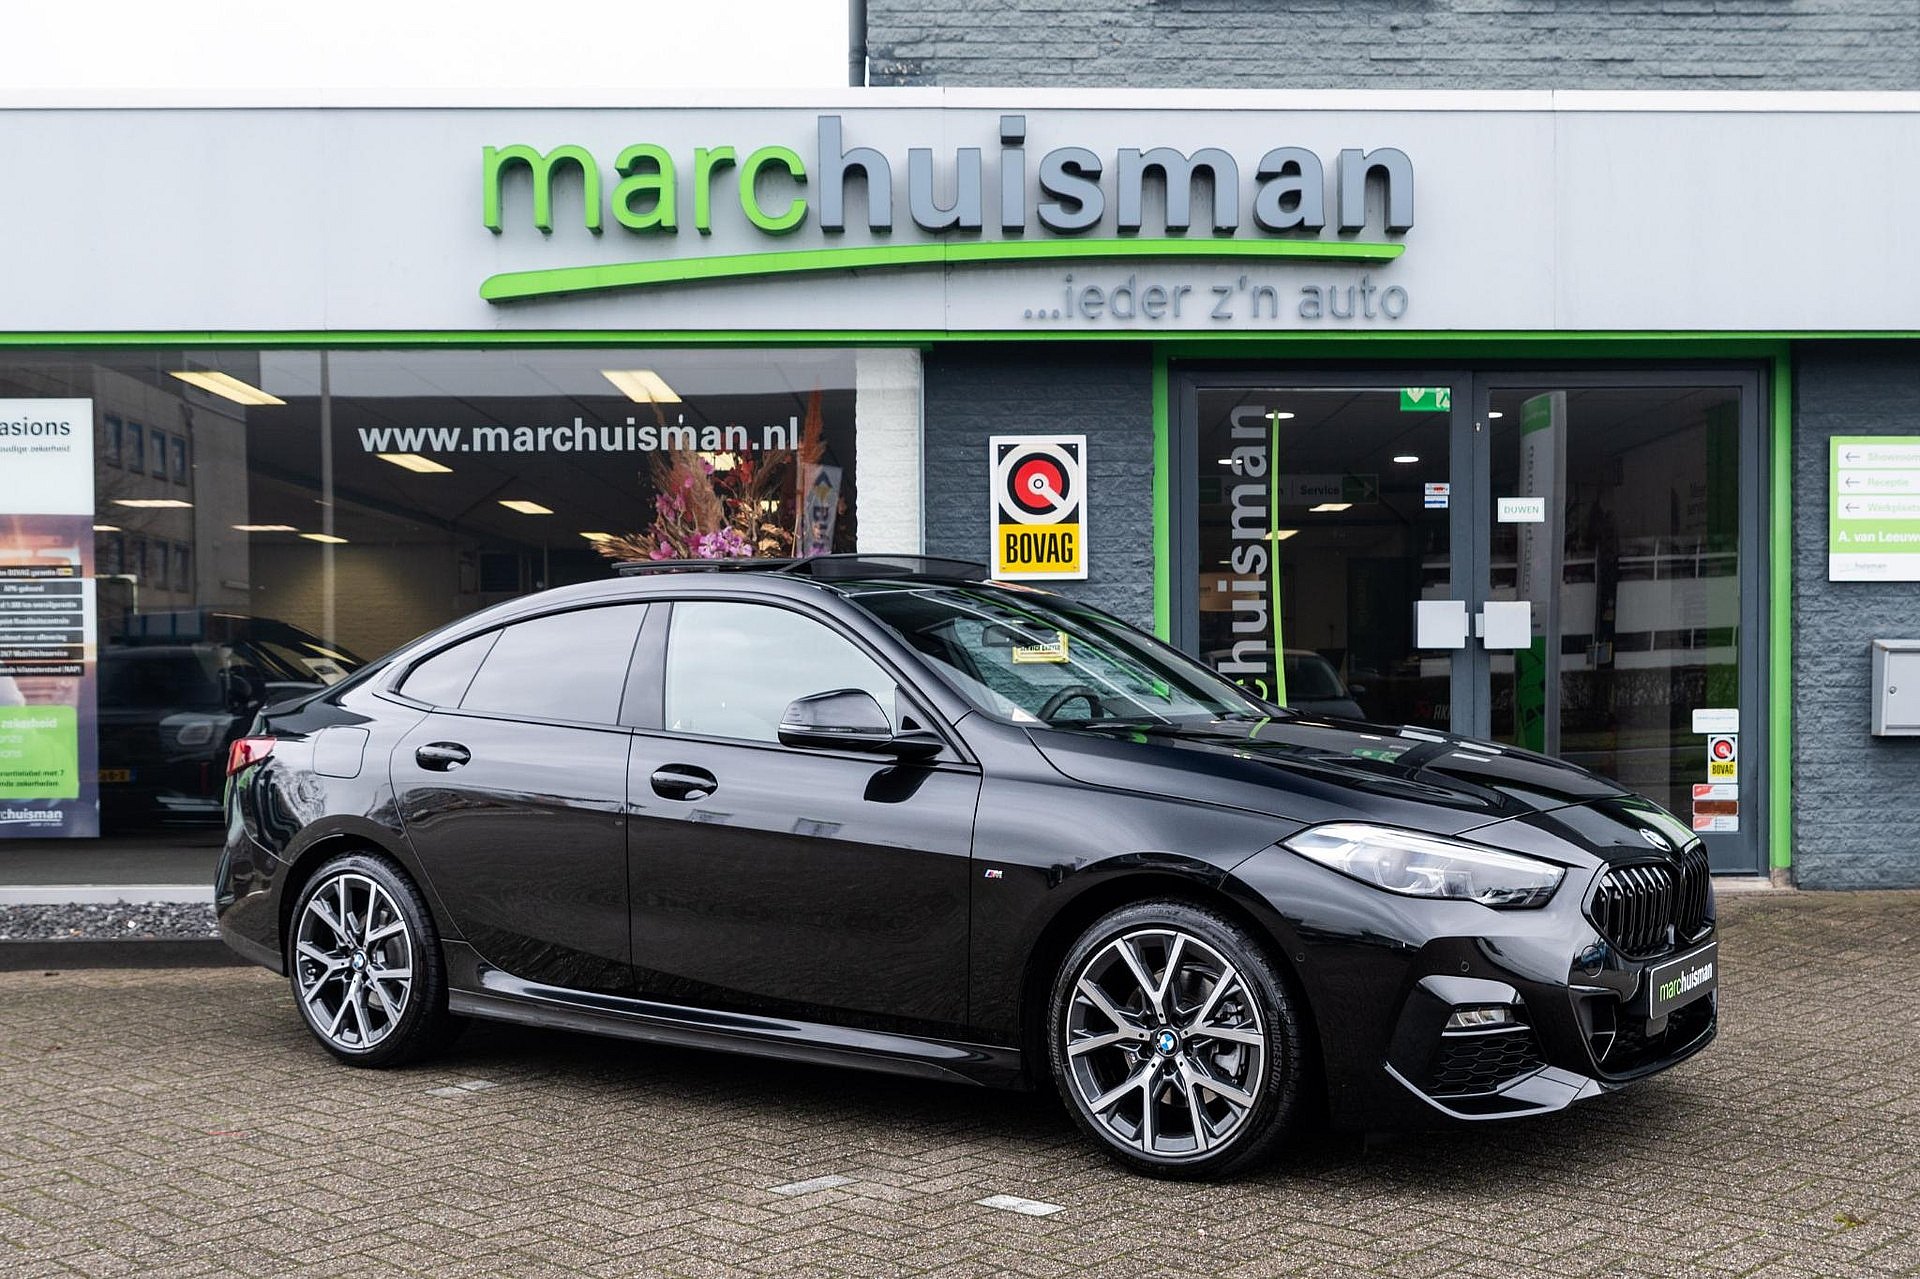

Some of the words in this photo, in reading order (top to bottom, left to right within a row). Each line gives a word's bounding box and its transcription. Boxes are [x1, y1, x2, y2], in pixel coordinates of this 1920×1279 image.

[482, 115, 1415, 236] marchuisman
[1210, 274, 1279, 320] z'n
[1299, 273, 1411, 320] auto
[358, 416, 799, 453] www.marchuisman.nl
[1300, 486, 1340, 496] Service
[1503, 506, 1540, 515] DUWEN
[1006, 532, 1073, 564] BOVAG
[1839, 530, 1850, 542] A.
[1855, 533, 1875, 542] van
[1712, 764, 1734, 775] BOVAG
[1660, 962, 1713, 1003] marchuisman
